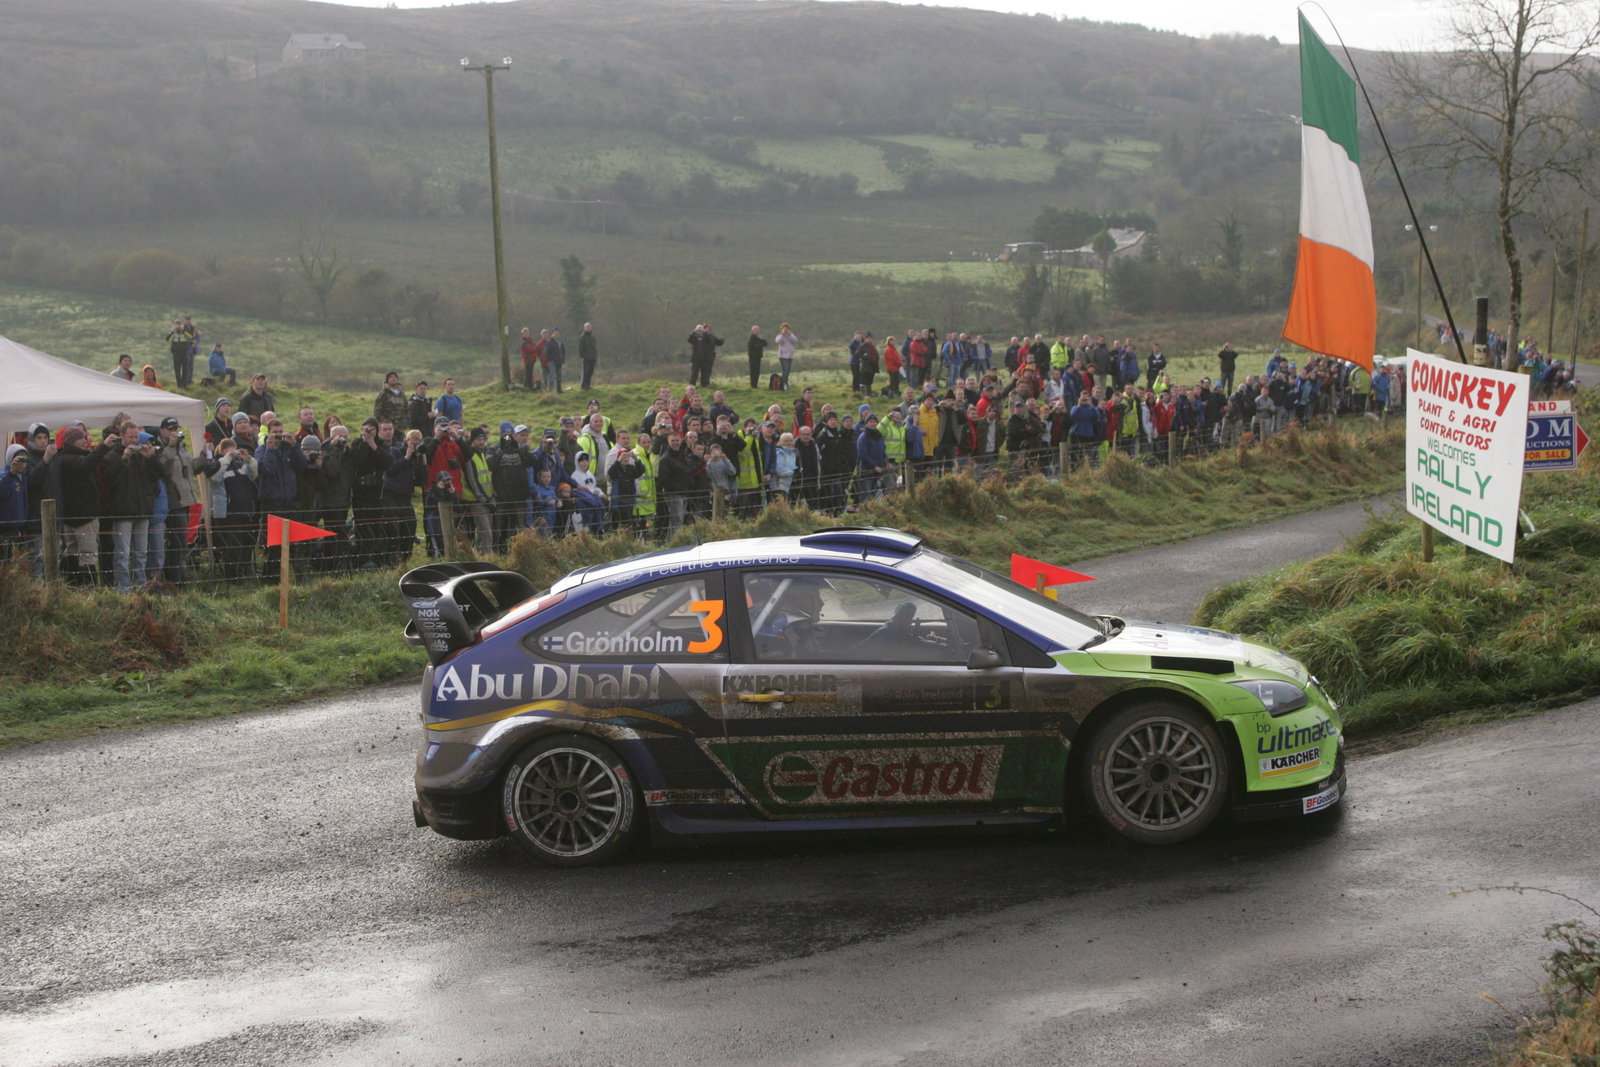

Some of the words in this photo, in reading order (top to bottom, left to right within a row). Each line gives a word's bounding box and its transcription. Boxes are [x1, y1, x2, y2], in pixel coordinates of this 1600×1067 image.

[1411, 359, 1516, 417] COMISKEY
[1418, 398, 1442, 418] PLANT
[1448, 409, 1456, 422] &
[1463, 414, 1497, 433] AGRI
[1420, 417, 1492, 450] CONTRACTORS
[1427, 436, 1476, 467] WELCOMES
[1524, 451, 1541, 460] FOR
[1545, 450, 1566, 459] SALE
[1417, 448, 1493, 500] RALLY
[1411, 482, 1503, 547] IRELAND
[418, 609, 440, 618] NGK
[687, 600, 724, 653] 3
[566, 631, 683, 653] Grönholm
[436, 663, 524, 701] Abu
[532, 663, 662, 700] Dhabi
[1256, 722, 1271, 735] bp
[1270, 747, 1320, 770] KÄRCHER
[821, 754, 986, 800] Castrol
